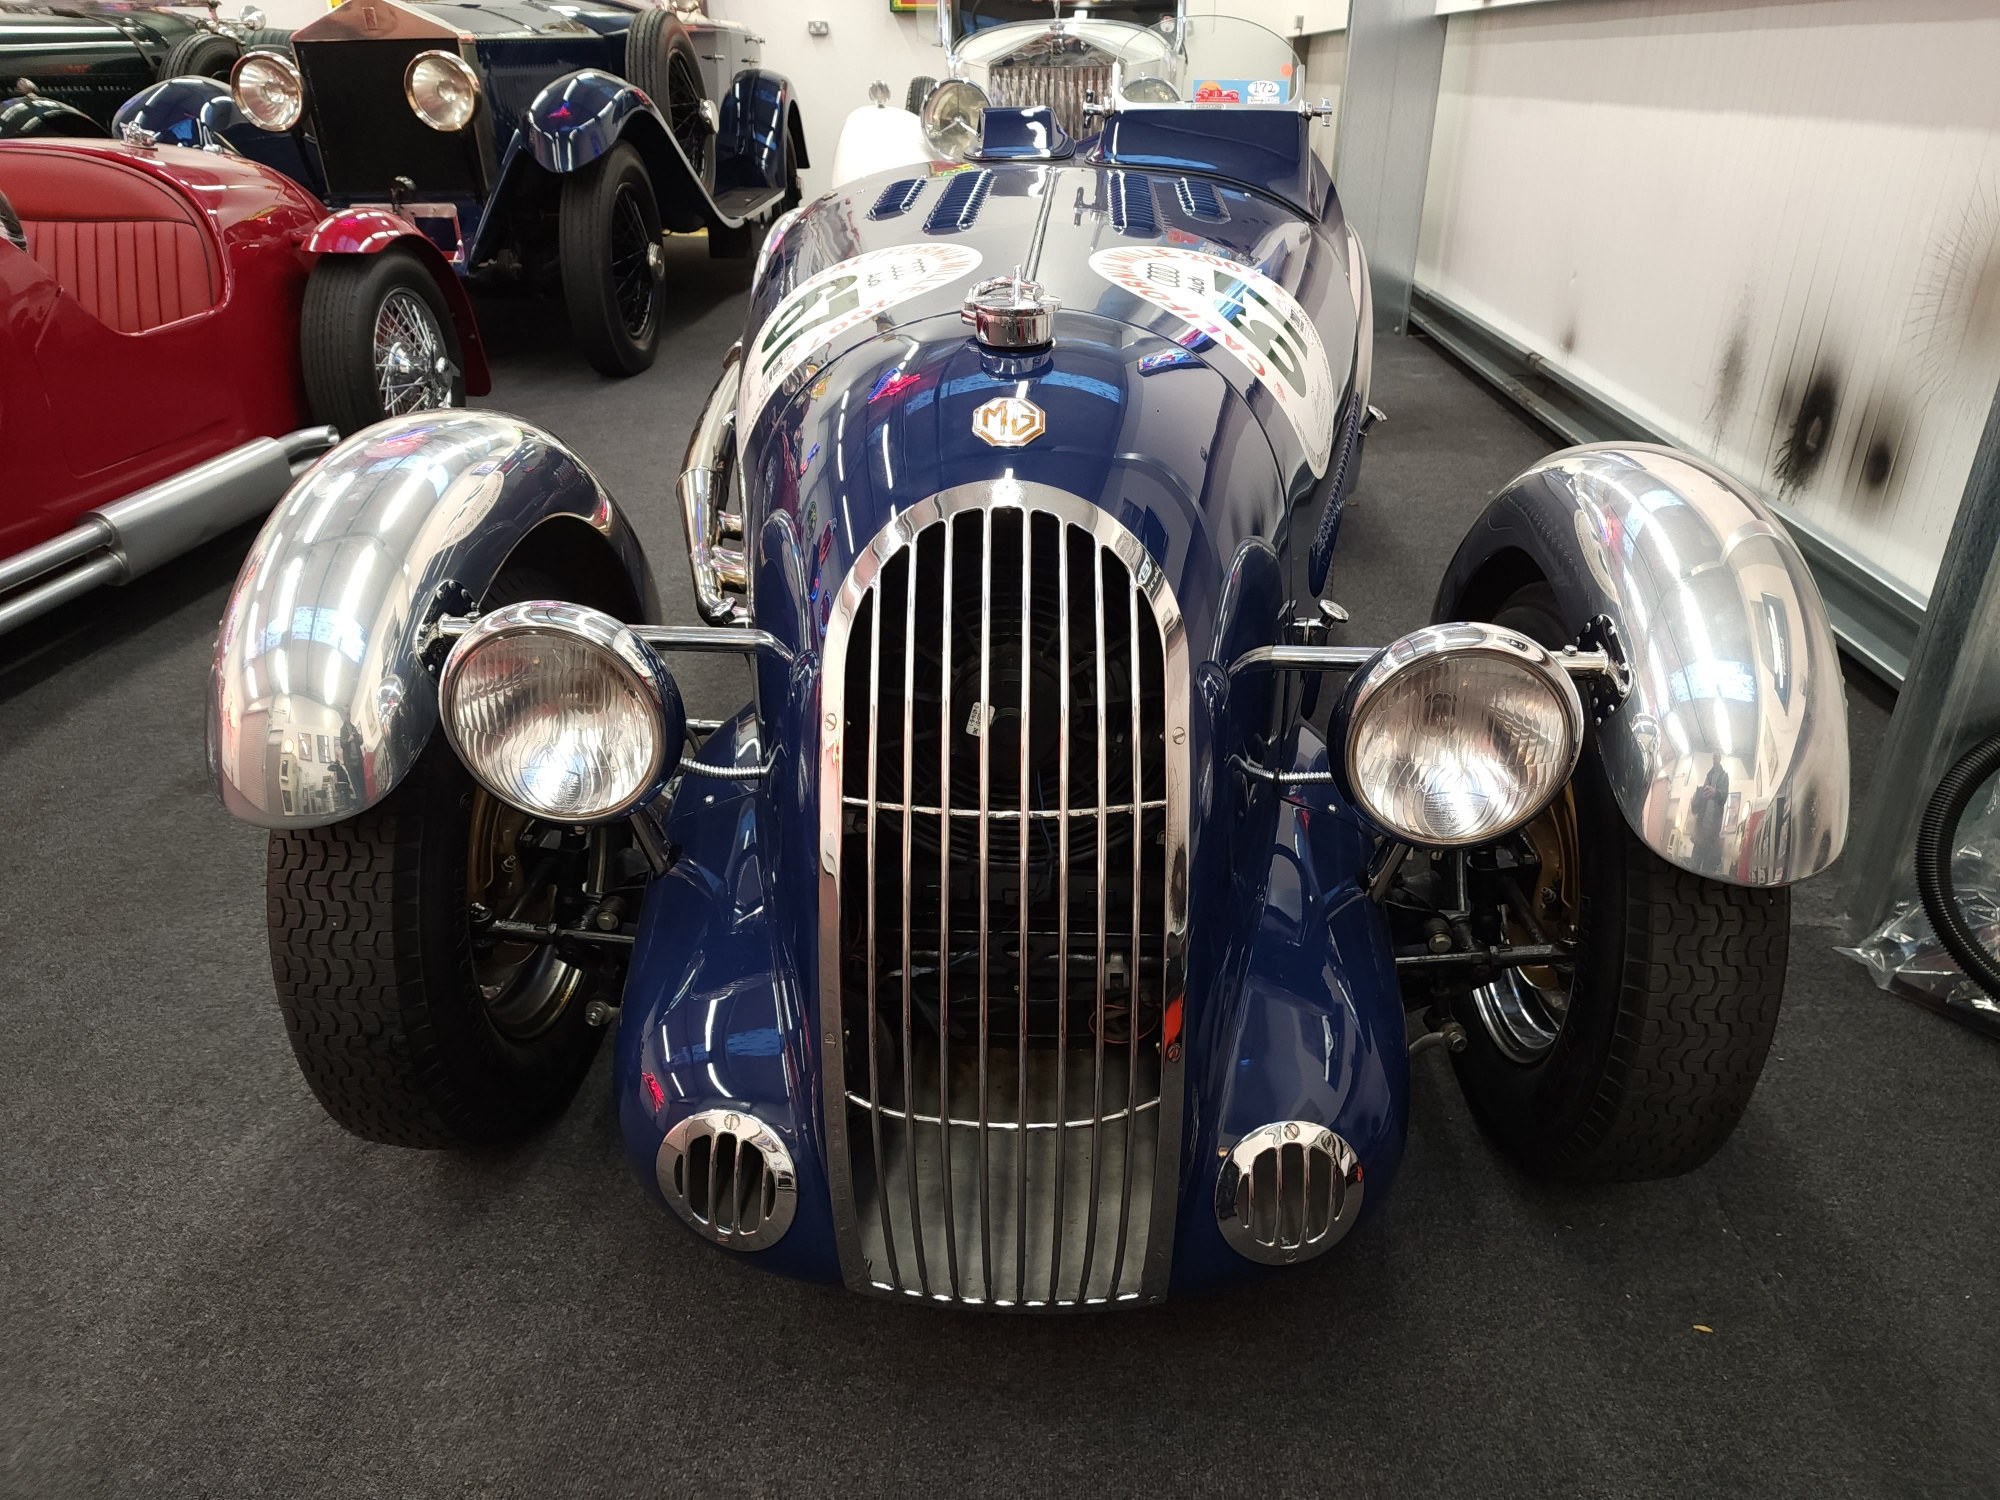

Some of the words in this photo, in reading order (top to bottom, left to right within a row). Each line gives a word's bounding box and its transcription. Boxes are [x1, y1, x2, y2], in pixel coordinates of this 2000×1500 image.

[1252, 82, 1277, 94] 172
[761, 275, 859, 377] 67
[1100, 262, 1266, 377] CALIFORNIA
[1187, 275, 1205, 297] Audi
[1213, 270, 1308, 399] 67
